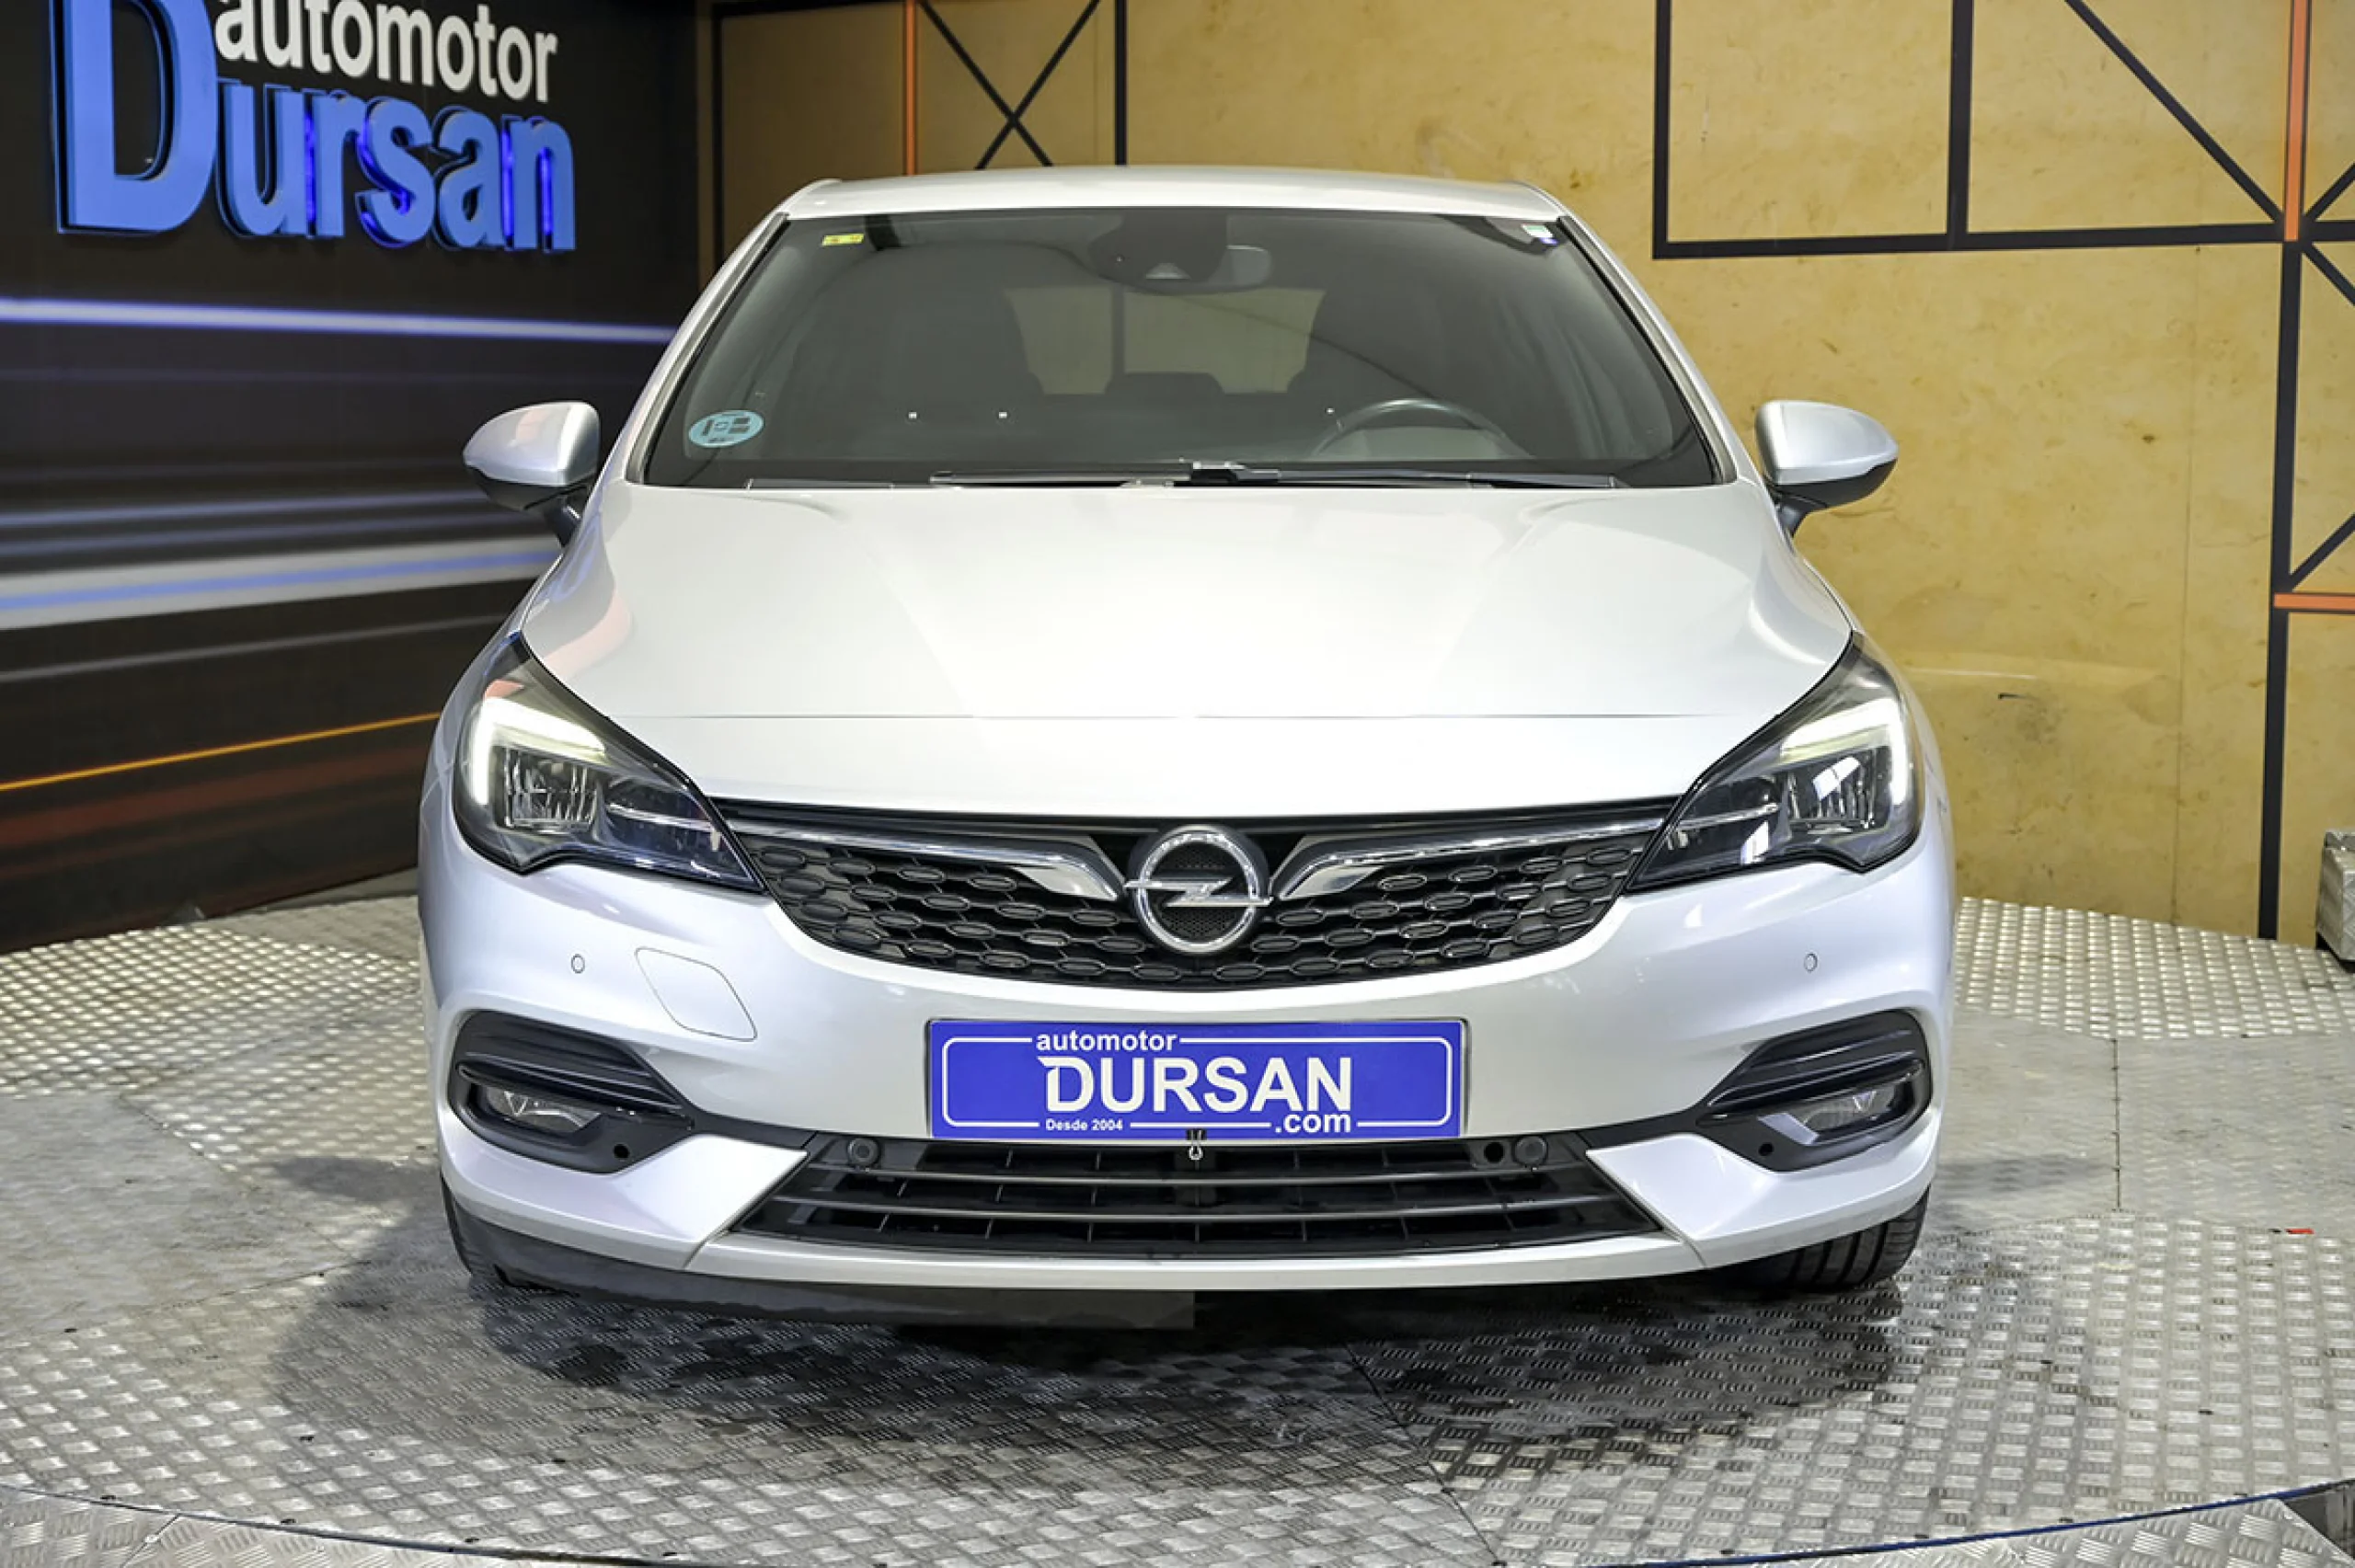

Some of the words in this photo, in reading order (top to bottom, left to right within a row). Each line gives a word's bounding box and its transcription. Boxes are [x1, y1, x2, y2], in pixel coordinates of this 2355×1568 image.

[214, 0, 558, 103] automotor
[53, 0, 576, 254] Dursan
[1036, 1029, 1178, 1051] automotor
[1037, 1055, 1352, 1113] DURSAN
[1045, 1117, 1088, 1131] Desde
[1092, 1118, 1123, 1131] 2004
[1275, 1112, 1352, 1134] .com
